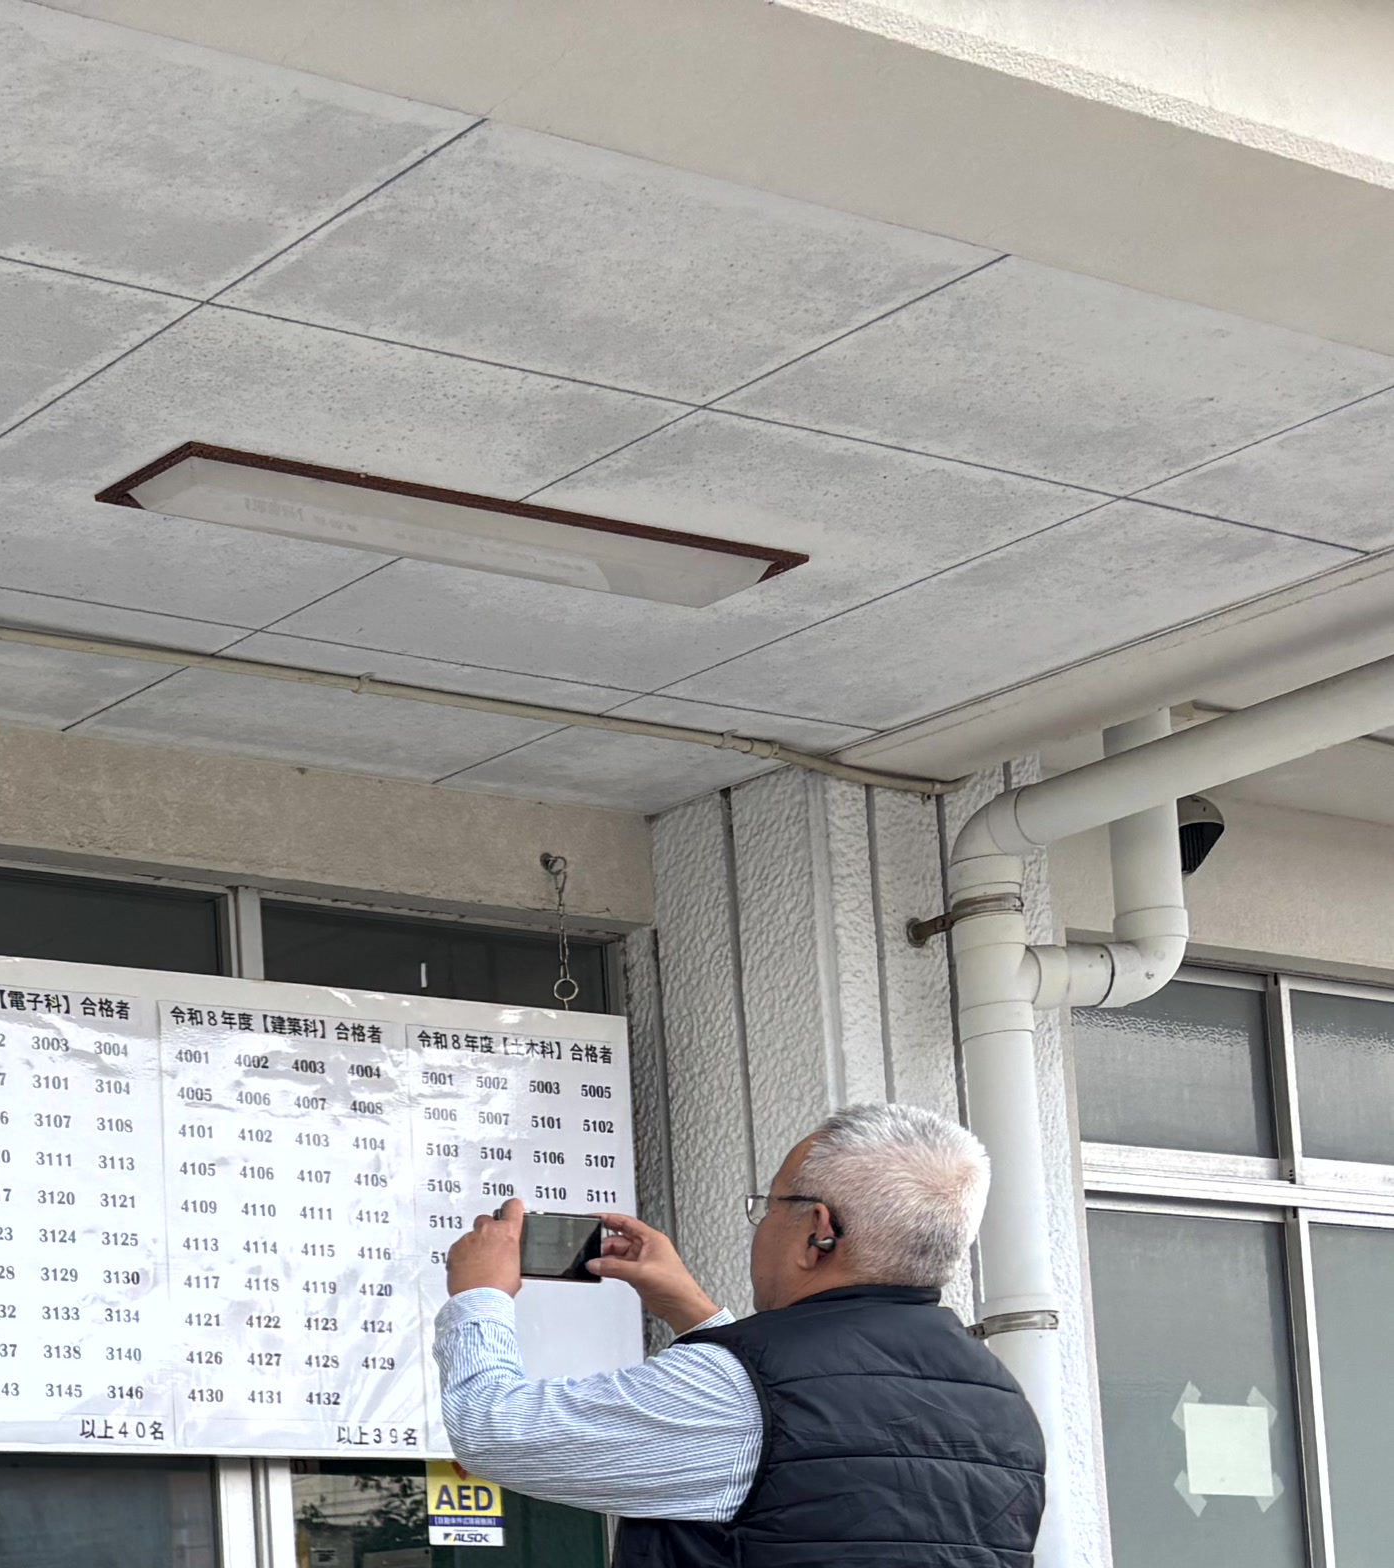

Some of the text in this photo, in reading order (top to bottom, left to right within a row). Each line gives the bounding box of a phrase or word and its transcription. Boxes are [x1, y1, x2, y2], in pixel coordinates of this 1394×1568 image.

[170, 1005, 383, 1044] 令和8年度【建築科】合格者
[234, 1054, 382, 1080] 4002 4003 4004
[32, 1074, 69, 1091] 3101
[528, 1079, 612, 1100] 5003 5005
[293, 1096, 327, 1112] 4007
[33, 1112, 72, 1129] 3107
[96, 1116, 134, 1133] 3108
[530, 1115, 615, 1134] 5101 5102
[237, 1127, 330, 1148] 4102 4103
[35, 1151, 72, 1168] 3111
[98, 1154, 136, 1172] 3113
[479, 1146, 616, 1169] 5104 5106 5107
[180, 1162, 332, 1185] 4105 4106 4107
[37, 1189, 76, 1206] 3120
[100, 1192, 136, 1209] 3121
[482, 1182, 617, 1204] 5109 5110 5111
[180, 1199, 390, 1225] 4109 4110 4111 4112
[429, 1214, 463, 1230] 5113
[38, 1228, 77, 1244] 3124
[101, 1231, 139, 1247] 3125
[182, 1236, 392, 1261] 4113 4114 4115 4116
[40, 1266, 79, 1283] 3129
[103, 1269, 141, 1286] 3130
[183, 1274, 394, 1298] 4117 4118 4119 4120
[41, 1305, 81, 1321] 3133
[104, 1307, 141, 1324] 3134
[184, 1312, 339, 1332] 4121 4122 4123
[43, 1344, 82, 1360] 3138
[105, 1346, 142, 1363] 3140
[185, 1350, 396, 1371] 4126 4127 4128 4129
[45, 1382, 83, 1399] 3145
[106, 1384, 144, 1400] 3146
[187, 1388, 341, 1406] 4130 4131 4132
[79, 1419, 165, 1441] 以上40名
[336, 1425, 418, 1446] 以上39名
[435, 1485, 494, 1511] AED
